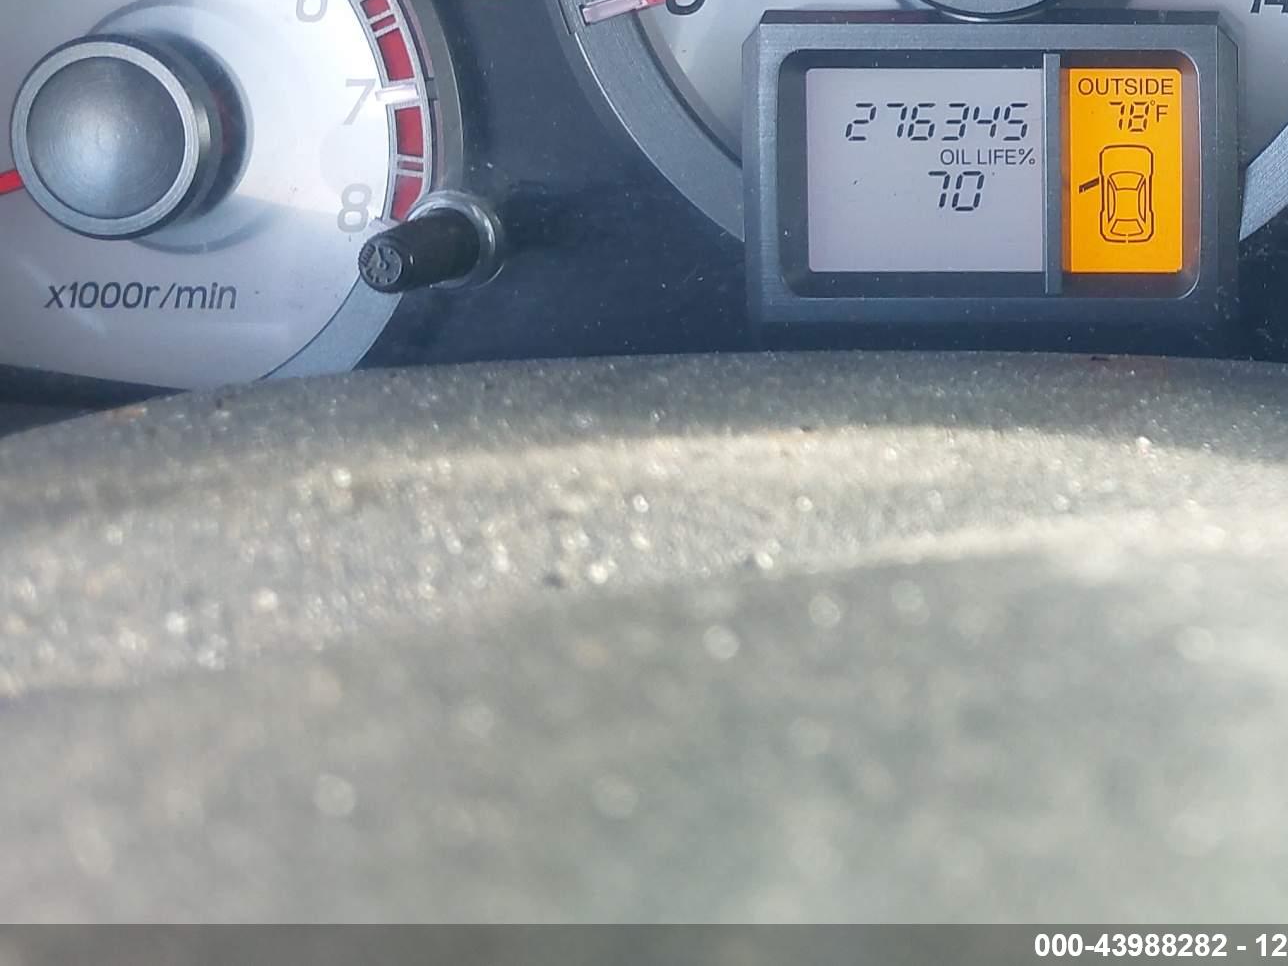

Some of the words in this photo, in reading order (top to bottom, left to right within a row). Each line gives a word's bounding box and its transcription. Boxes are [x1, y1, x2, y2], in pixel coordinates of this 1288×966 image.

[345, 79, 376, 126] 7
[1077, 78, 1174, 96] OUTSIDE
[845, 103, 1029, 141] 276345
[940, 149, 971, 166] OIL
[337, 184, 372, 233] 8
[928, 171, 985, 212] 70
[45, 282, 237, 310] x1000r/min
